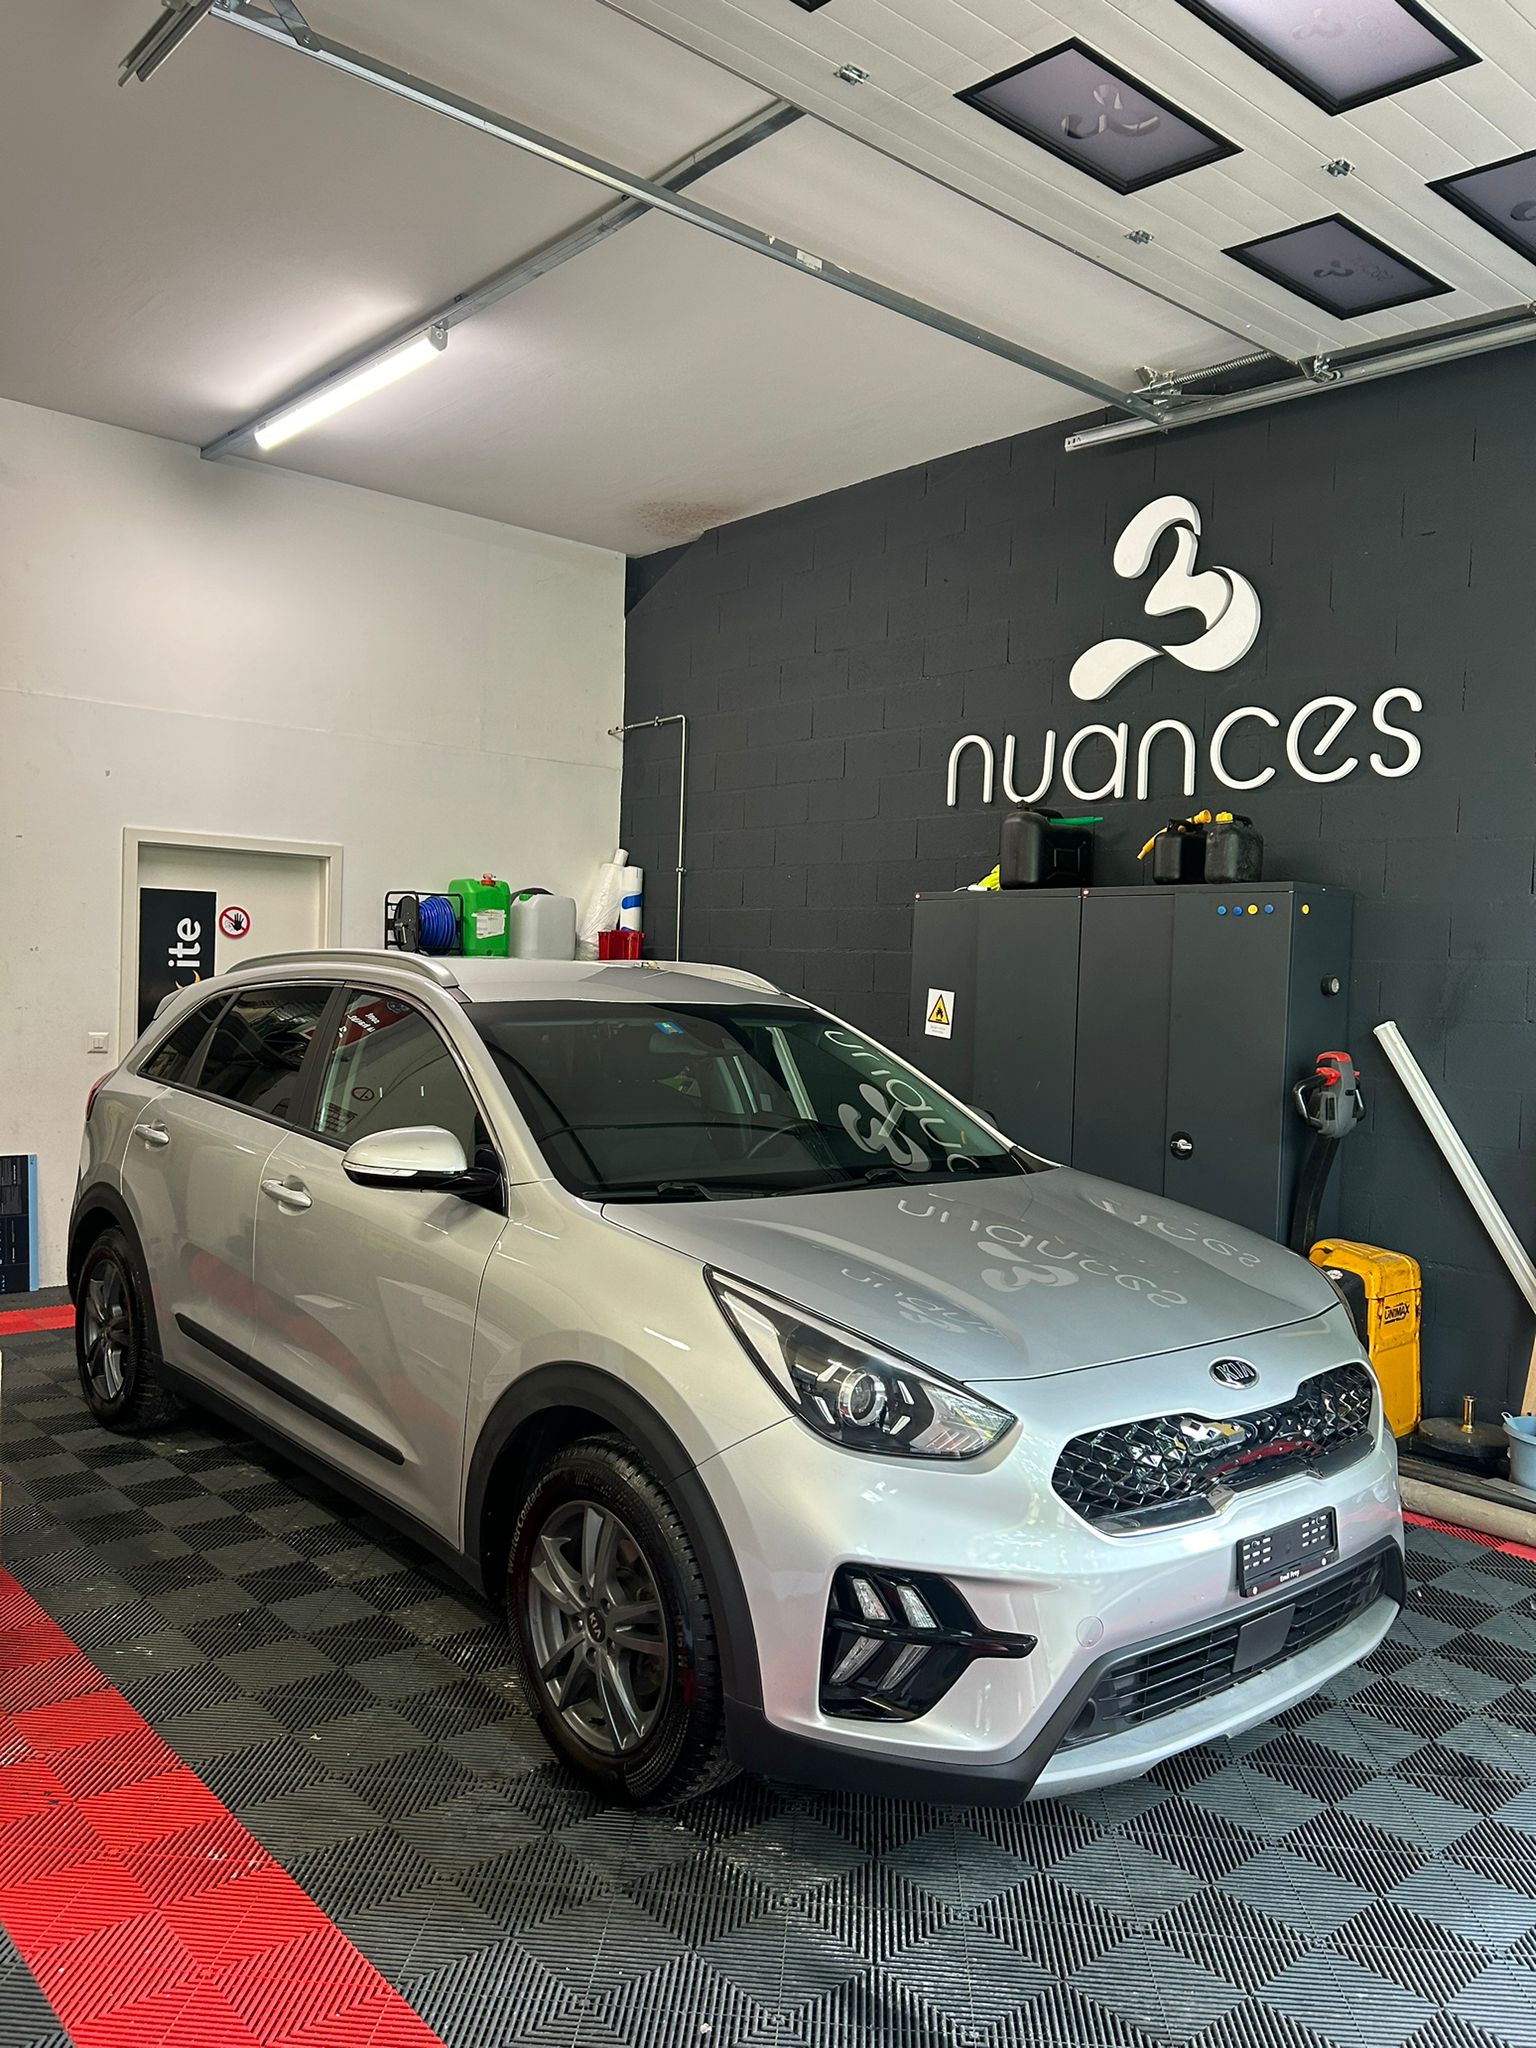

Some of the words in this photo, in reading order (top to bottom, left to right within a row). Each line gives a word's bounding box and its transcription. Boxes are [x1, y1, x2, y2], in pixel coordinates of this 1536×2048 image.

[946, 686, 1424, 807] nuances
[168, 917, 202, 970] ite
[1384, 1304, 1410, 1321] UNIMAX
[1215, 1361, 1255, 1382] KIA
[589, 1612, 602, 1639] KIA
